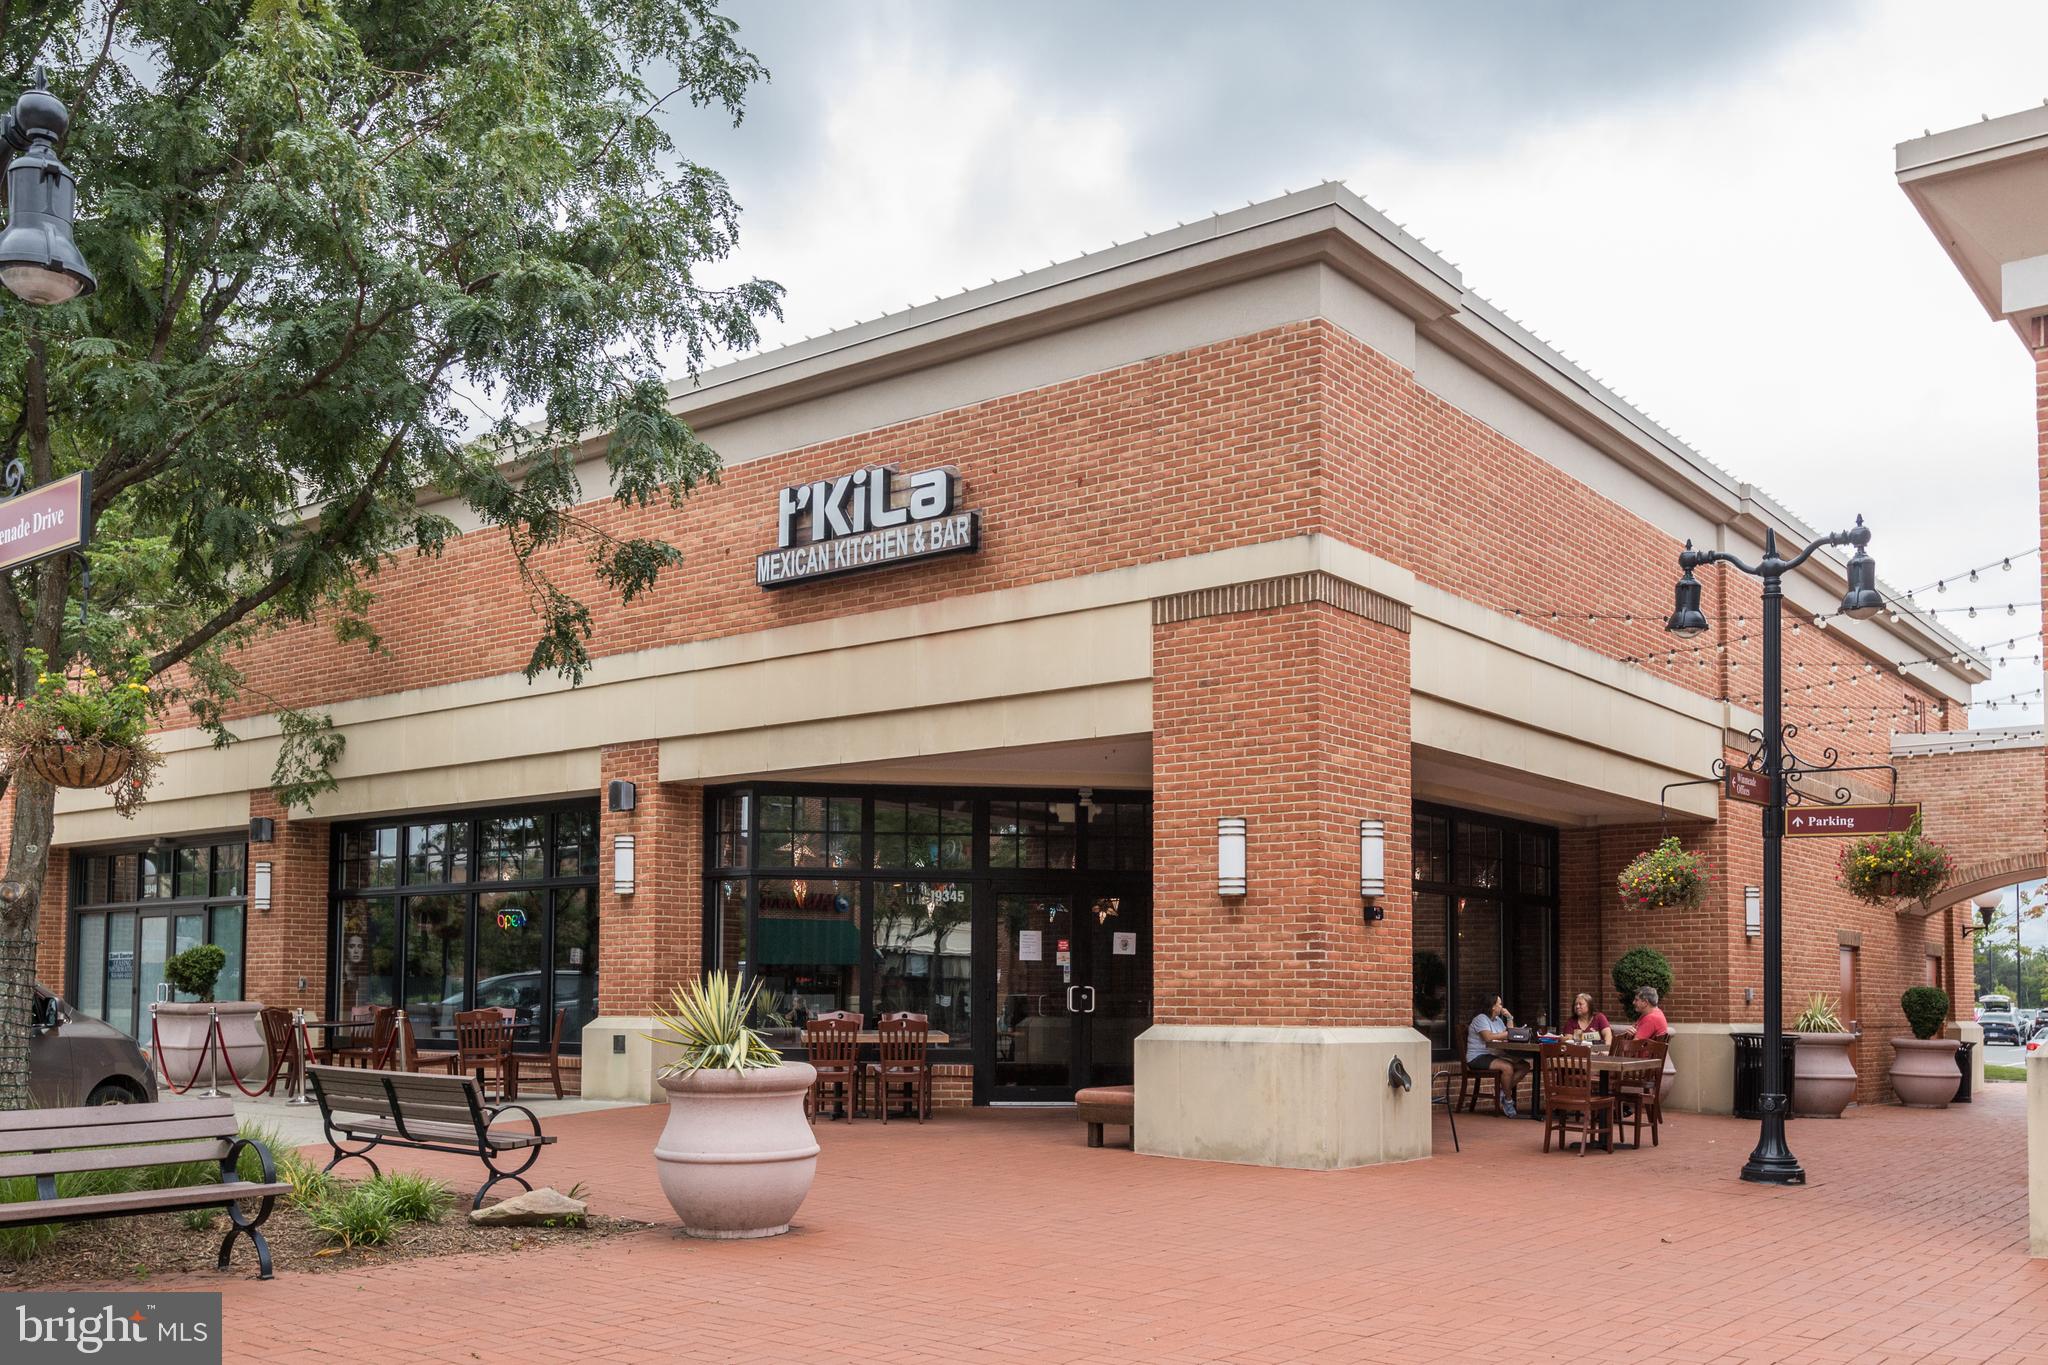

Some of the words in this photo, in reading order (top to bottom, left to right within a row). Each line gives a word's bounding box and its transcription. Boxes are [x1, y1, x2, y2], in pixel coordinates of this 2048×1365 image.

[32, 507, 64, 534] Drive
[757, 543, 830, 583] MEXICAN
[834, 528, 908, 569] KITCHEN
[913, 525, 926, 553] &
[930, 516, 970, 551] BAR
[1807, 815, 1855, 828] Parking
[930, 889, 965, 903] 19345
